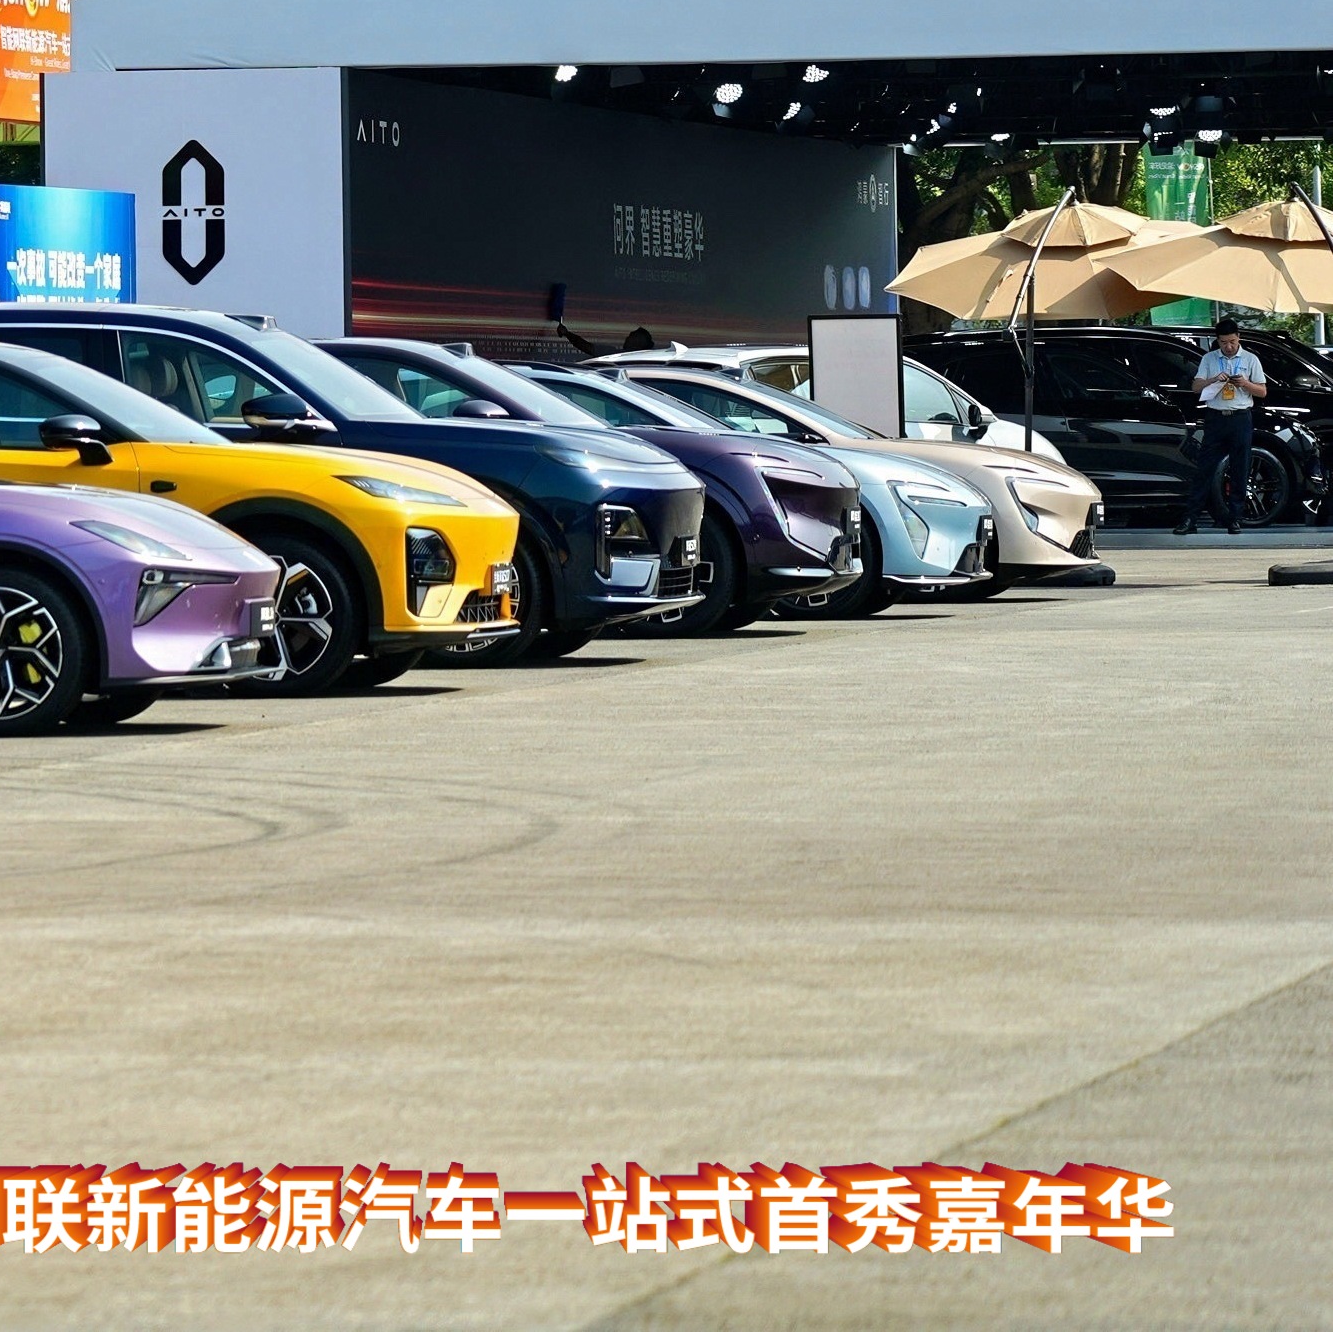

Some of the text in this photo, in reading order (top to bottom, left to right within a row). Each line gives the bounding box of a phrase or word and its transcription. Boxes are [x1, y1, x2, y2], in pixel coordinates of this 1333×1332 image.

[357, 119, 400, 147] AITO
[163, 208, 225, 217] AITO
[614, 202, 704, 262] 问界 智慧重塑豪华
